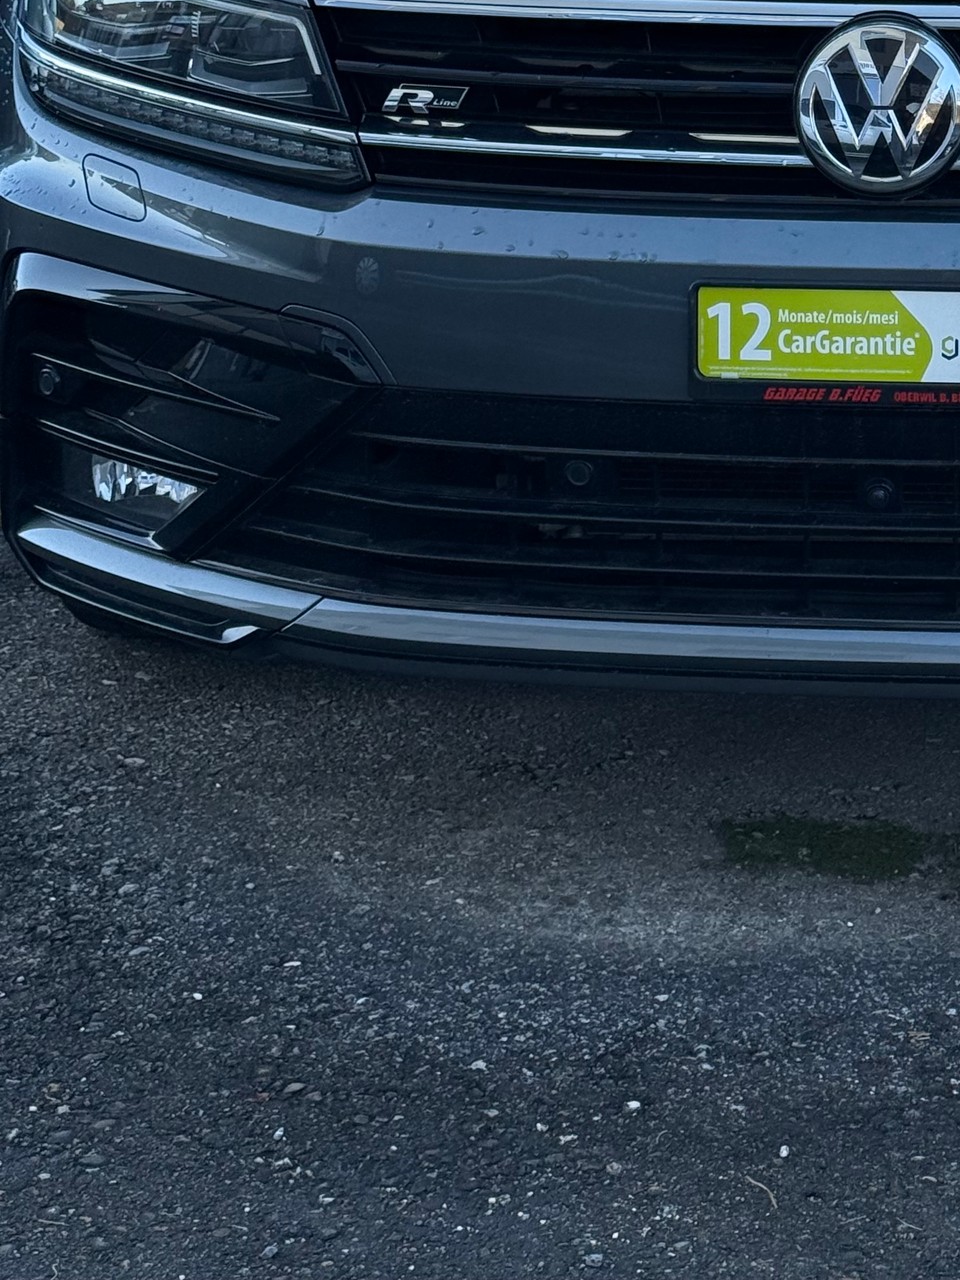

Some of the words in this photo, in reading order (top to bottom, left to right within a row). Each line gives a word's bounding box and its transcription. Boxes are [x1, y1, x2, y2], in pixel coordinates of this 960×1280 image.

[382, 88, 435, 114] R
[432, 98, 459, 108] Line
[777, 308, 899, 325] Monate/mois/mesi
[706, 301, 773, 362] 12
[777, 328, 917, 356] CarGarantie
[763, 386, 827, 401] GARAGE
[893, 391, 937, 403] OBERWIL
